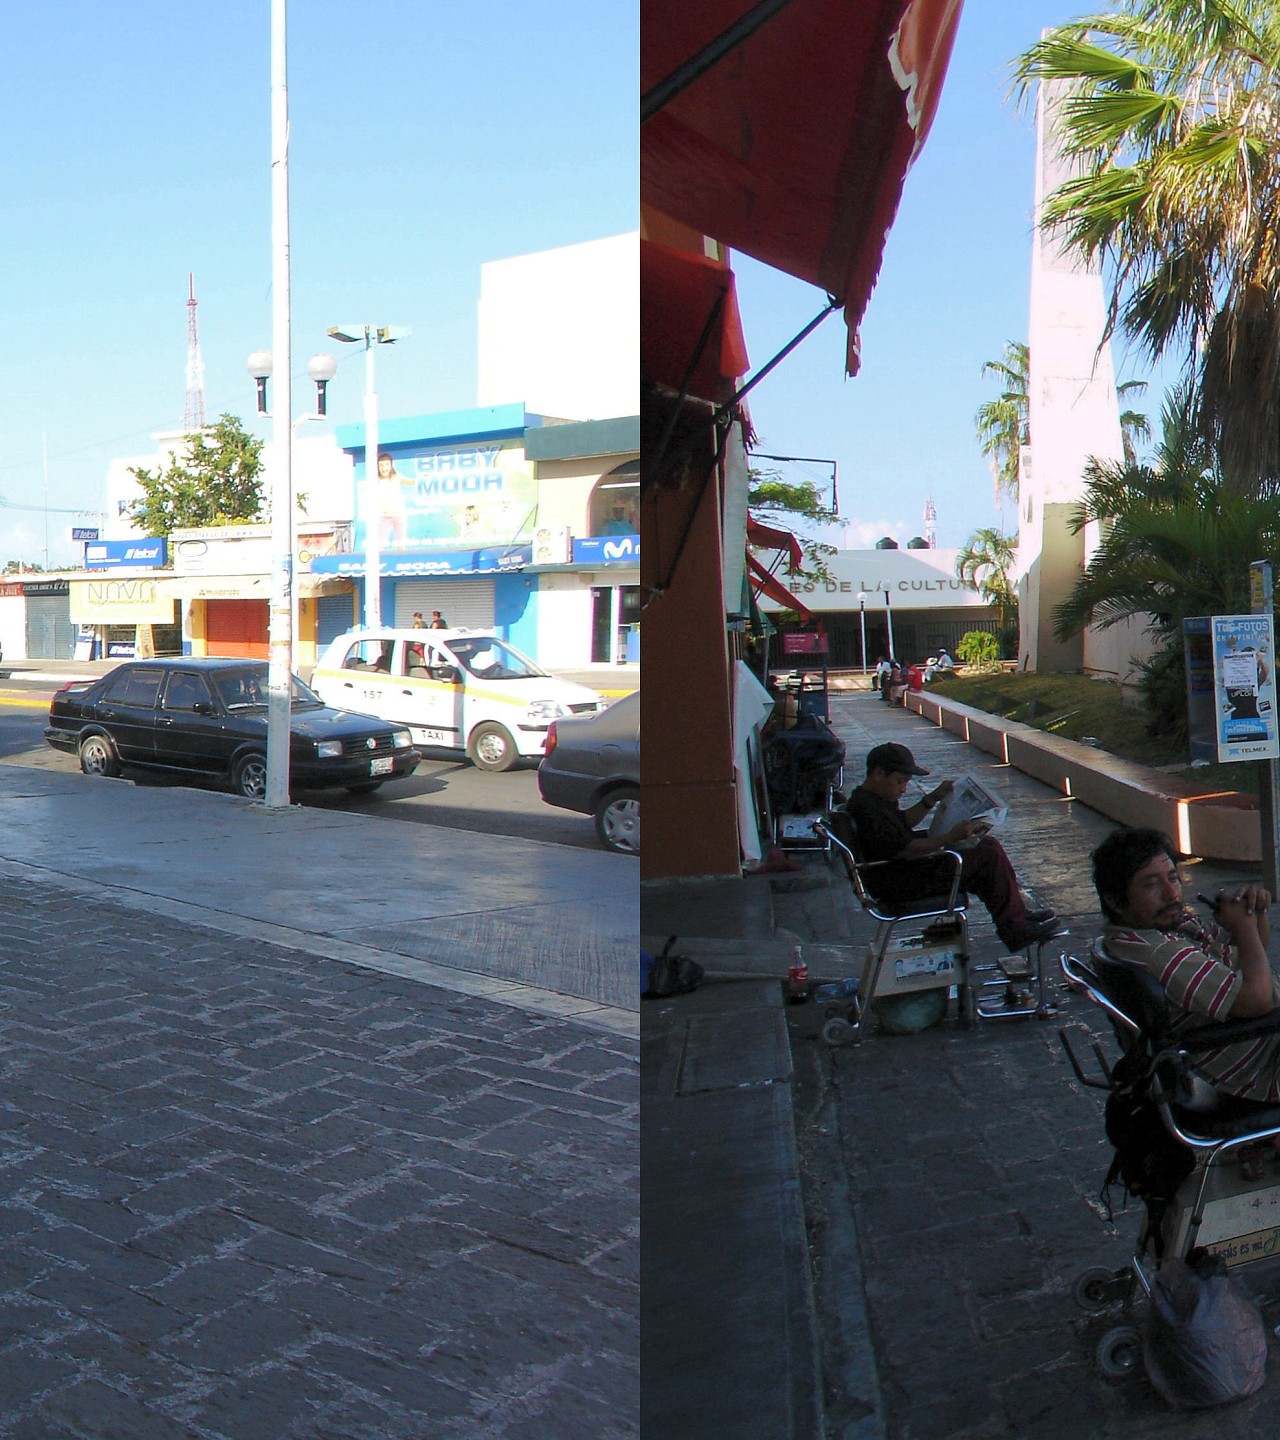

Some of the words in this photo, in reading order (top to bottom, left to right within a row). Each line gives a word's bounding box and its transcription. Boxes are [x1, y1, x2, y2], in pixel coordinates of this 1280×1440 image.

[80, 529, 98, 539] telcel
[132, 547, 158, 559] telcel
[338, 562, 386, 571] BAY
[396, 561, 451, 570] MODA
[826, 581, 851, 592] DE
[1239, 621, 1268, 631] FOTOS
[363, 690, 382, 699] 157
[421, 729, 444, 740] TAXI
[1240, 1244, 1250, 1254] es
[1252, 1237, 1263, 1251] mi
